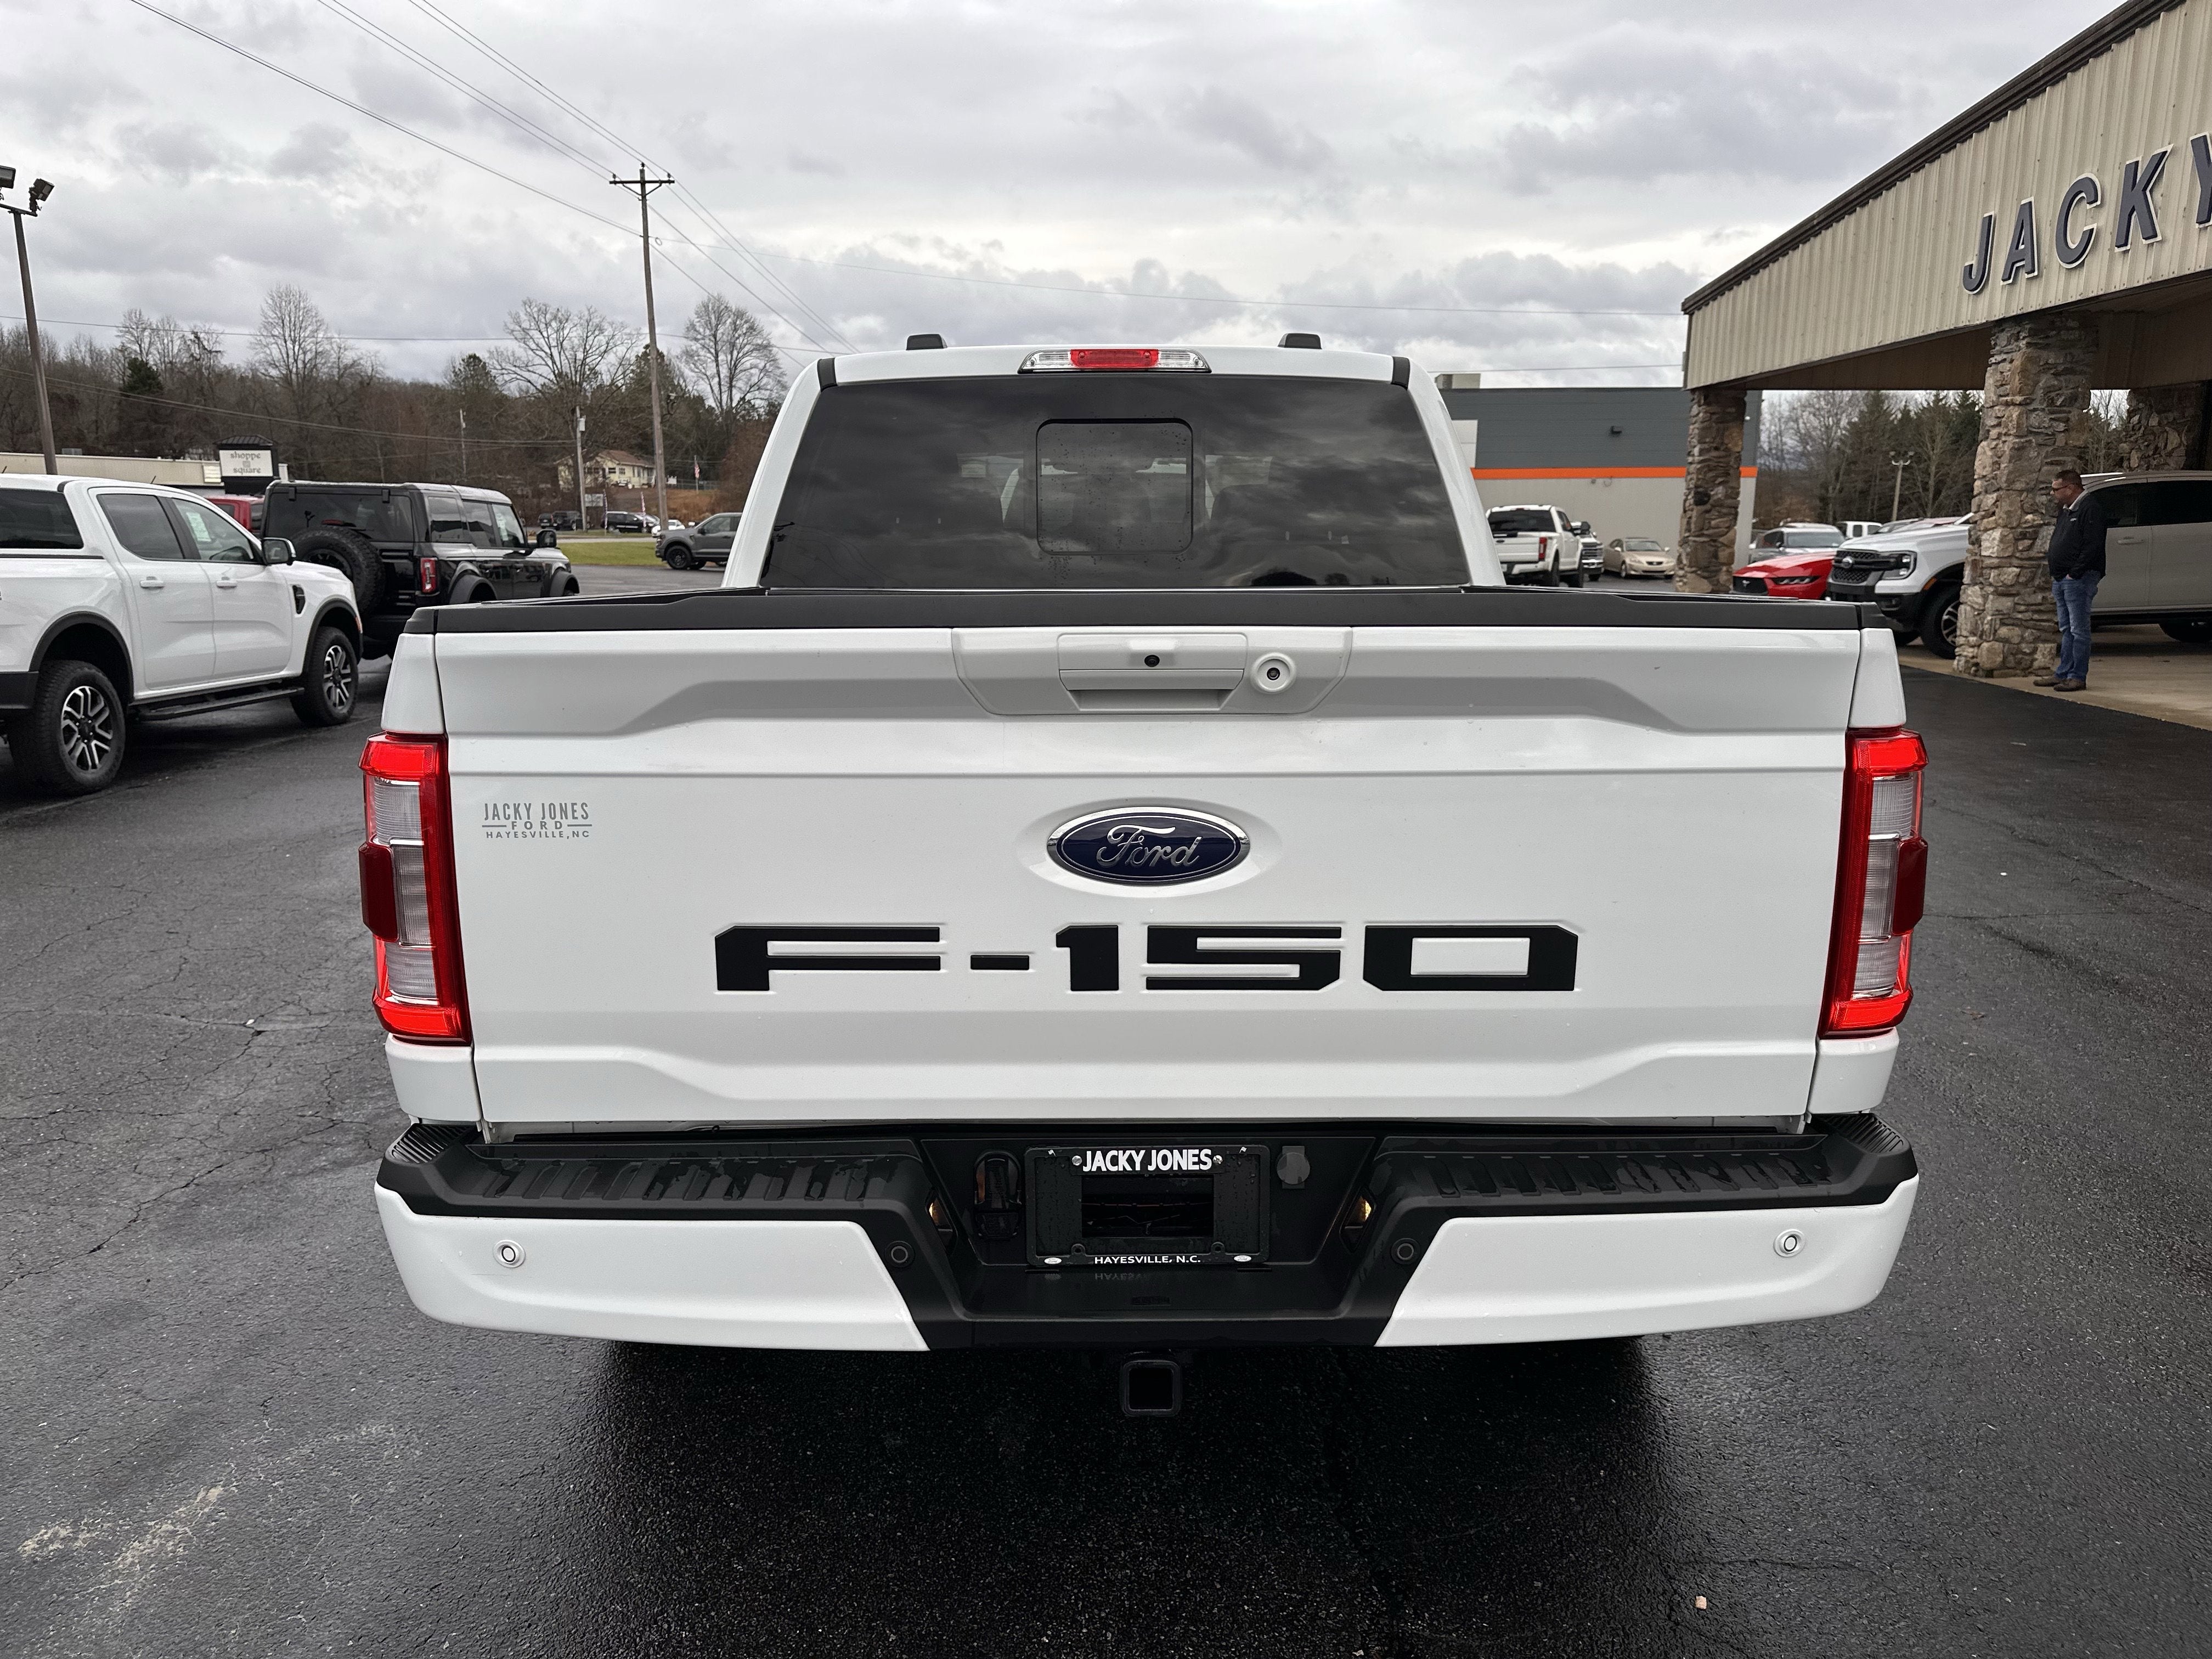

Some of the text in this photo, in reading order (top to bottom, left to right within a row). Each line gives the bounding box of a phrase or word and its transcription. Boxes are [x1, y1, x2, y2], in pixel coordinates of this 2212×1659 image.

[230, 451, 261, 460] shoppe
[484, 803, 589, 821] JACKY JONES
[511, 821, 562, 830] FORD
[1096, 824, 1203, 868] Ford
[714, 924, 1579, 992] F-150
[1082, 1149, 1212, 1172] JACKY JONES
[1094, 1256, 1173, 1264] HAYESVILLE,
